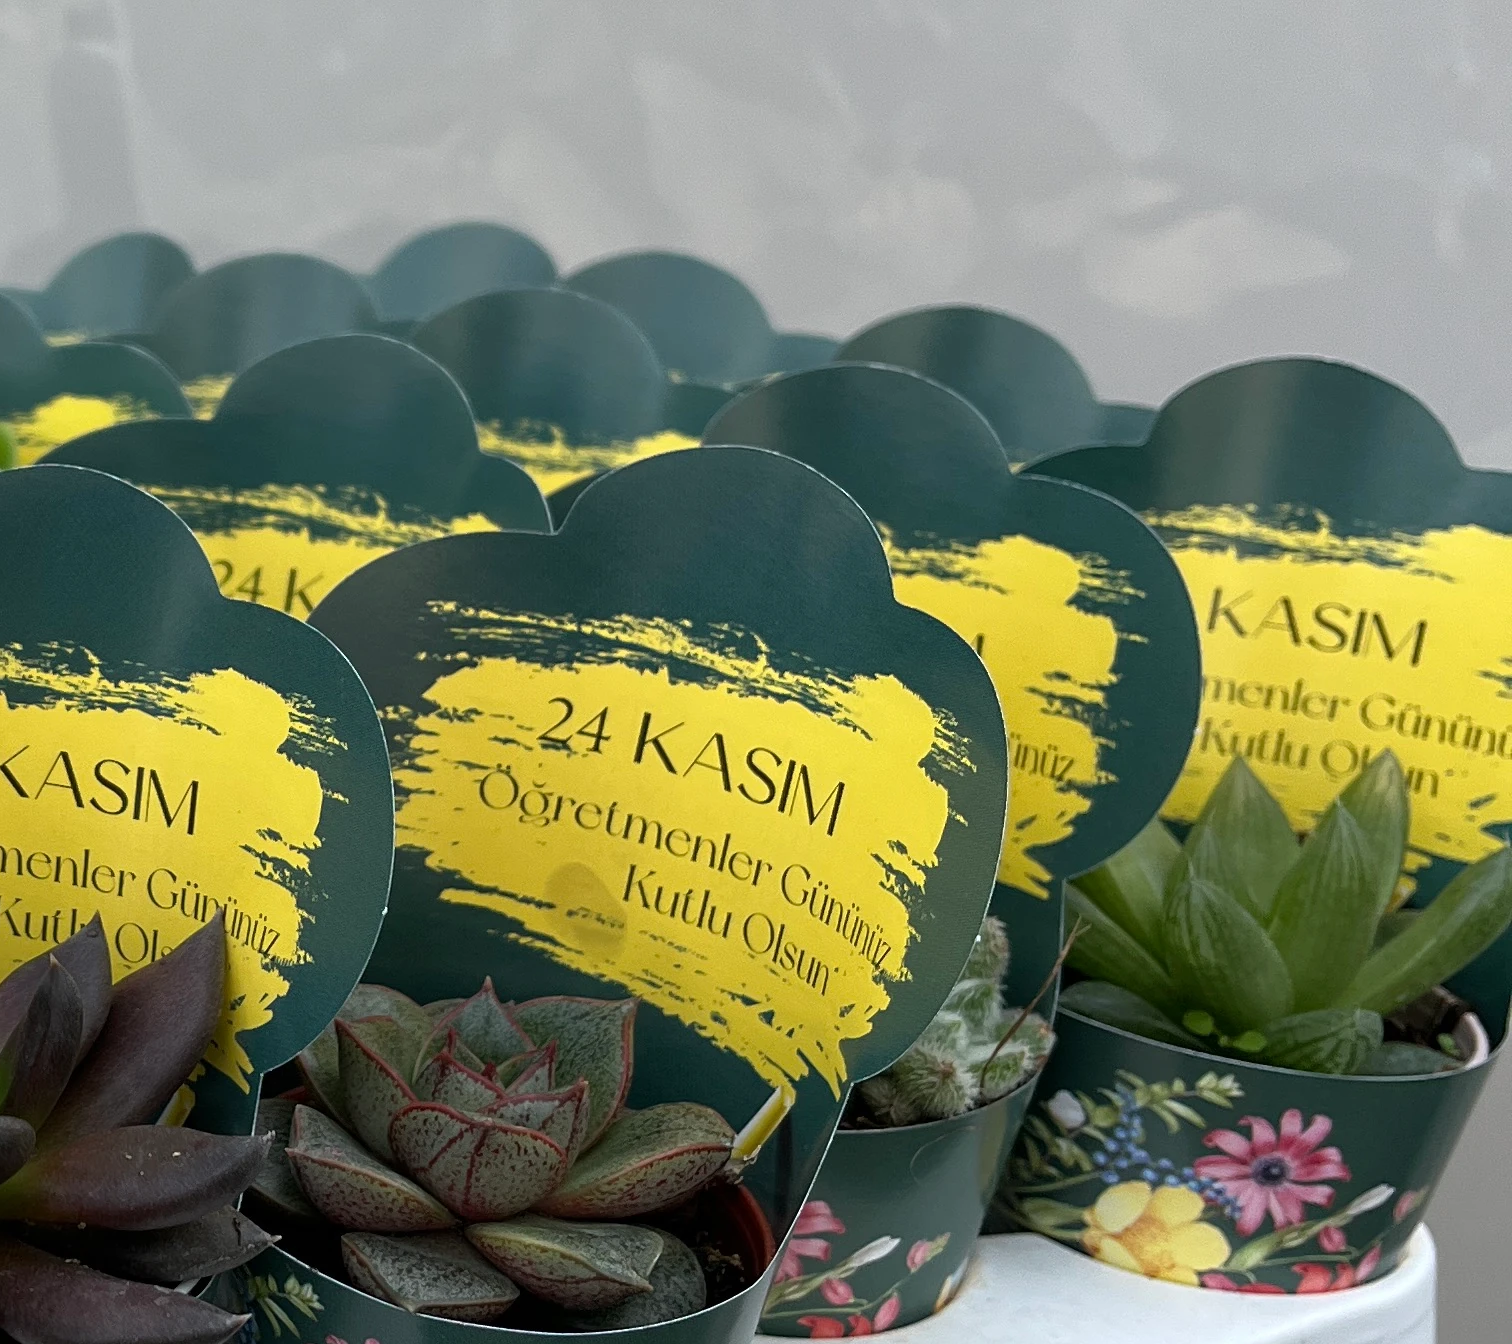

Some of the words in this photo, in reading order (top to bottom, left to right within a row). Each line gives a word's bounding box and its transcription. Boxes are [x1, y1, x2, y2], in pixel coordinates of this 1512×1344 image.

[1207, 586, 1428, 667] KASIM
[536, 697, 611, 753] 24
[633, 711, 845, 837] KASIM
[1200, 716, 1310, 770] Kutlu
[1320, 739, 1439, 798] Olun
[478, 763, 773, 887] Öğretmenler
[780, 863, 892, 968] Gününüz
[622, 863, 732, 939] Kutlu
[743, 912, 830, 996] Olsun
